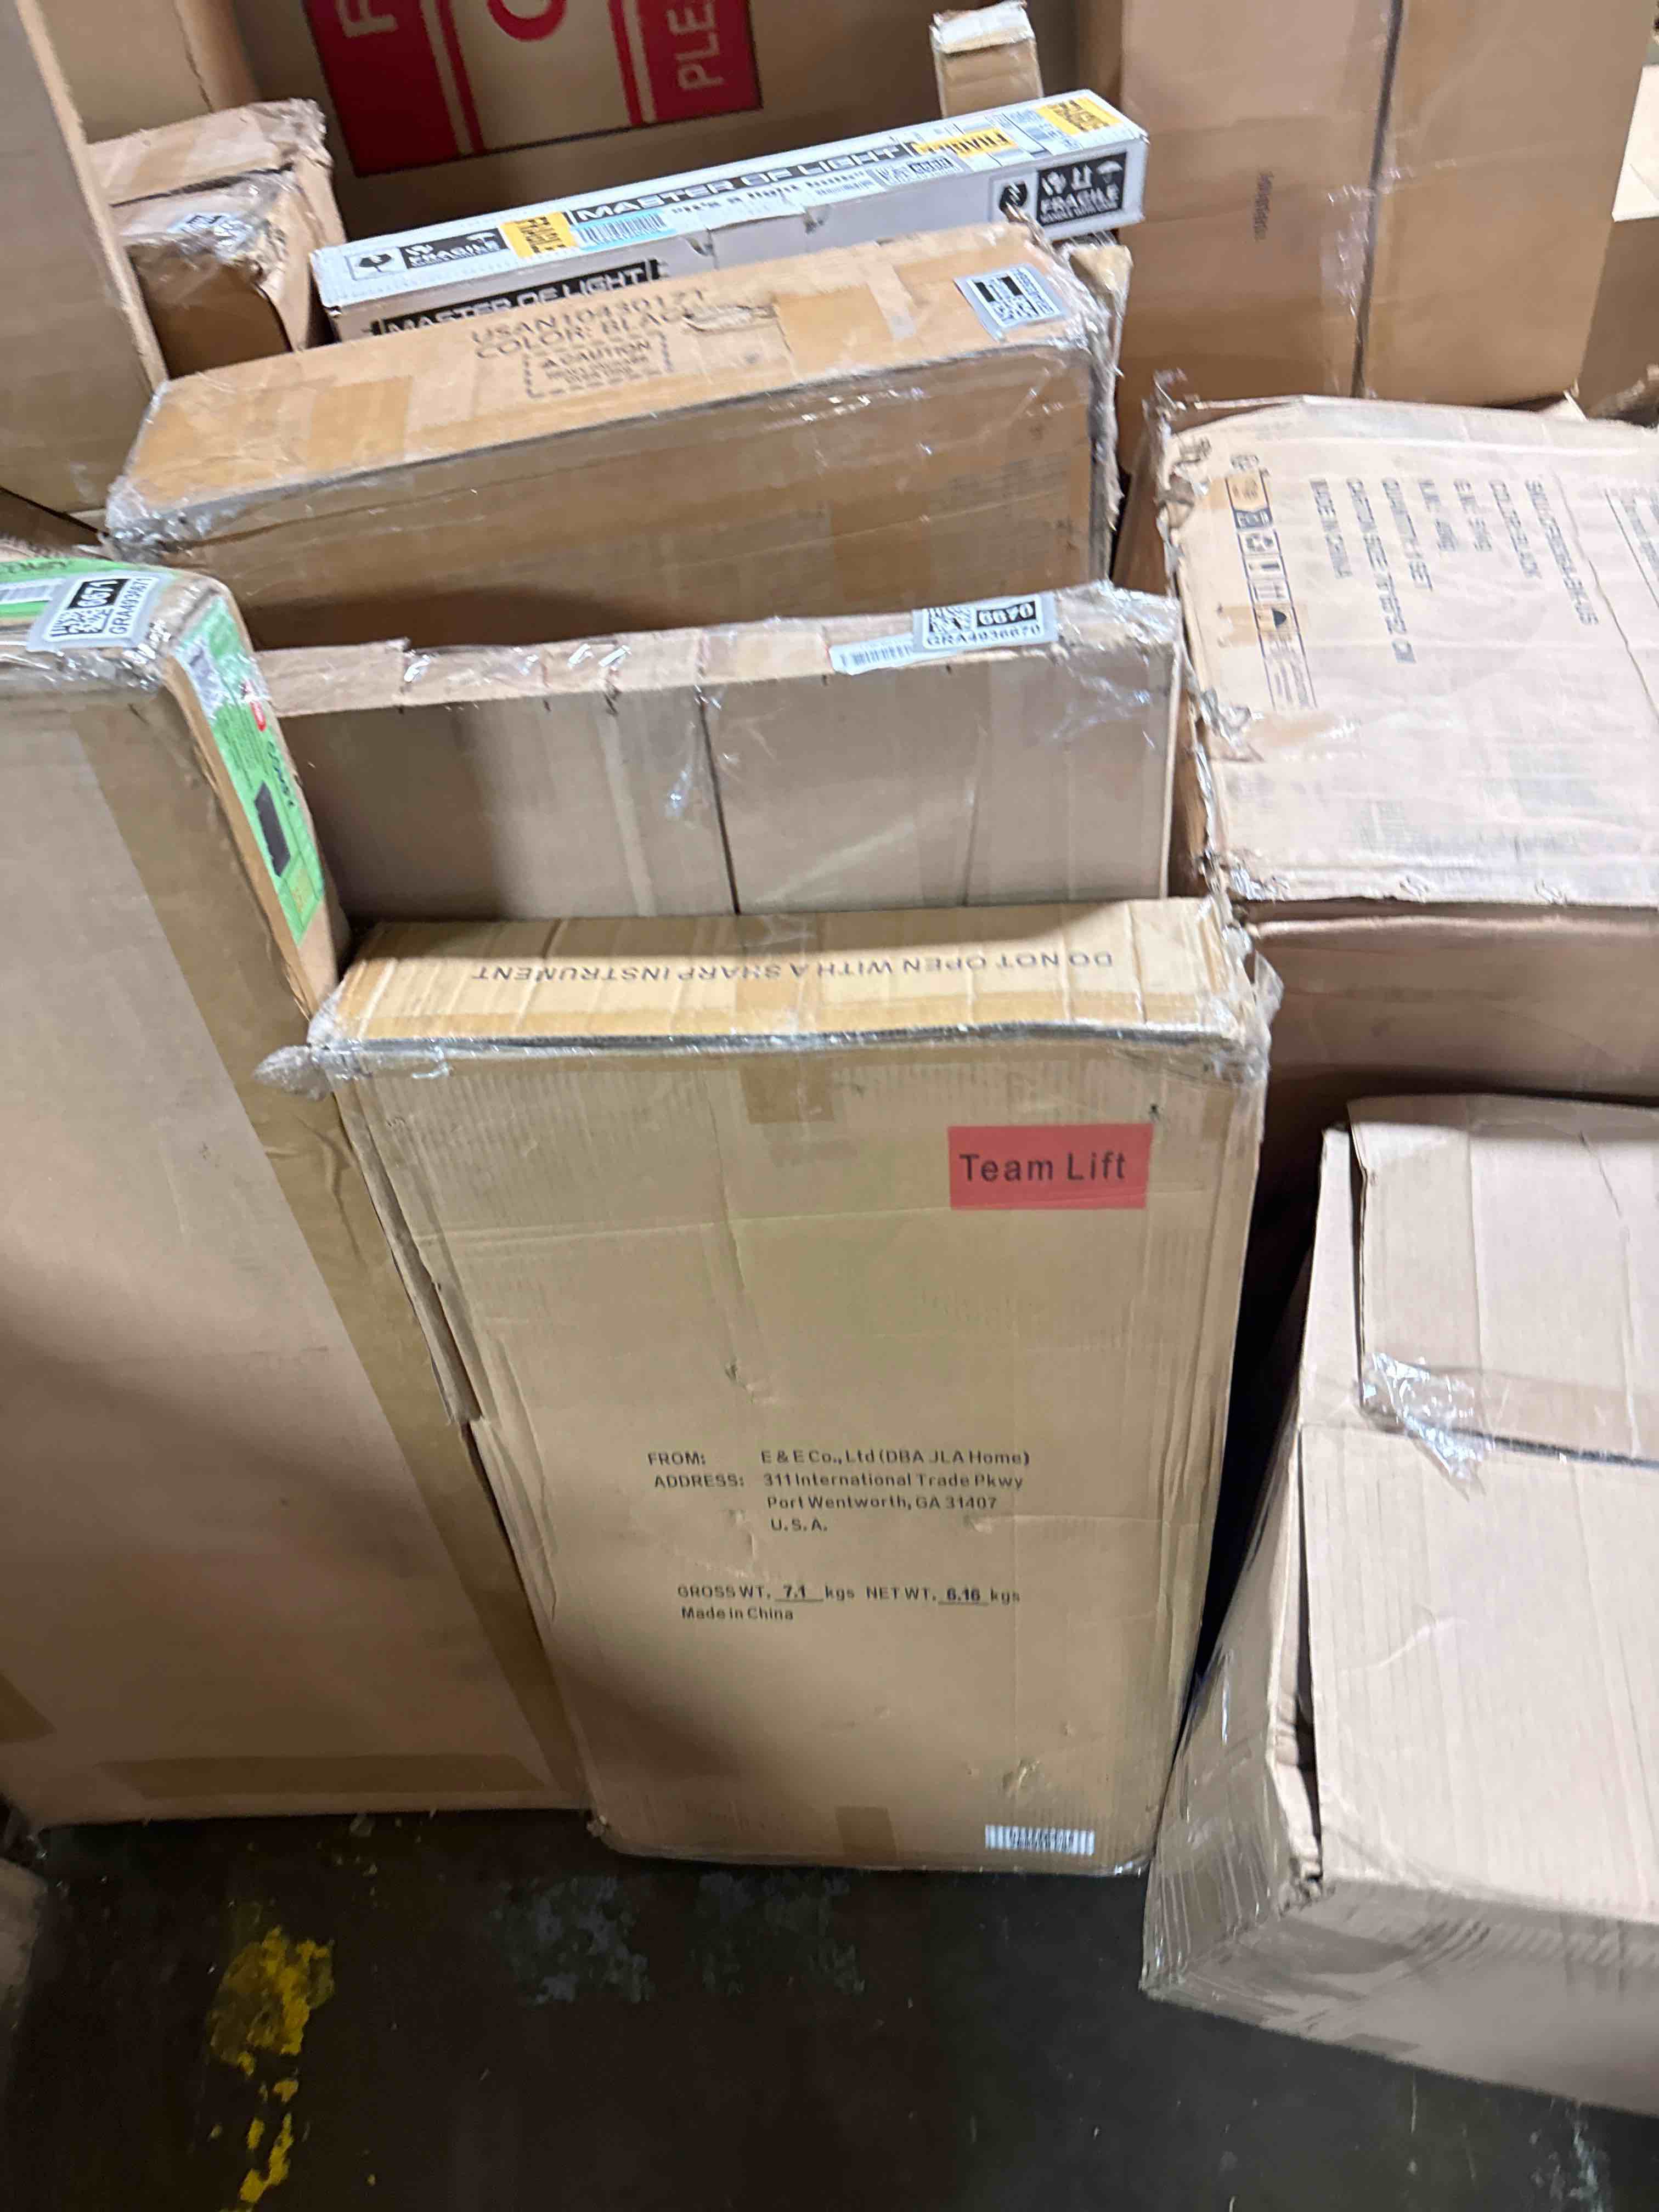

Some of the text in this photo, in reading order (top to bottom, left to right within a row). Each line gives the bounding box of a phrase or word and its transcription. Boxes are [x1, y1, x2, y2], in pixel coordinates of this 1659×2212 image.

[577, 179, 736, 220] MASTER
[741, 167, 792, 186] OF
[798, 146, 900, 176] LIGHT
[517, 287, 558, 307] OF
[562, 267, 644, 297] LIGHT
[979, 602, 1034, 627] 6670
[473, 950, 1113, 982] DO NOT OPEN WITH A SHARP INSTRUMENT
[960, 1152, 1126, 1182] Team Lift
[647, 1451, 706, 1465] FROM:
[761, 1450, 771, 1464] E
[776, 1450, 789, 1464] &
[929, 1450, 965, 1464] JLA
[969, 1450, 1030, 1466] Home)
[654, 1472, 1023, 1490] ADDRESS: 311 International Trade Pkwy
[768, 1495, 997, 1510] Port Wentworth, GA 31407
[770, 1518, 828, 1532] U.S.A.
[678, 1584, 736, 1598] GROSS
[740, 1584, 771, 1599] WT.
[825, 1585, 855, 1601] kgs
[866, 1586, 900, 1600] NET
[904, 1587, 937, 1601] WT.
[990, 1588, 1020, 1605] kgs
[681, 1606, 726, 1620] Made
[747, 1606, 794, 1621] China
